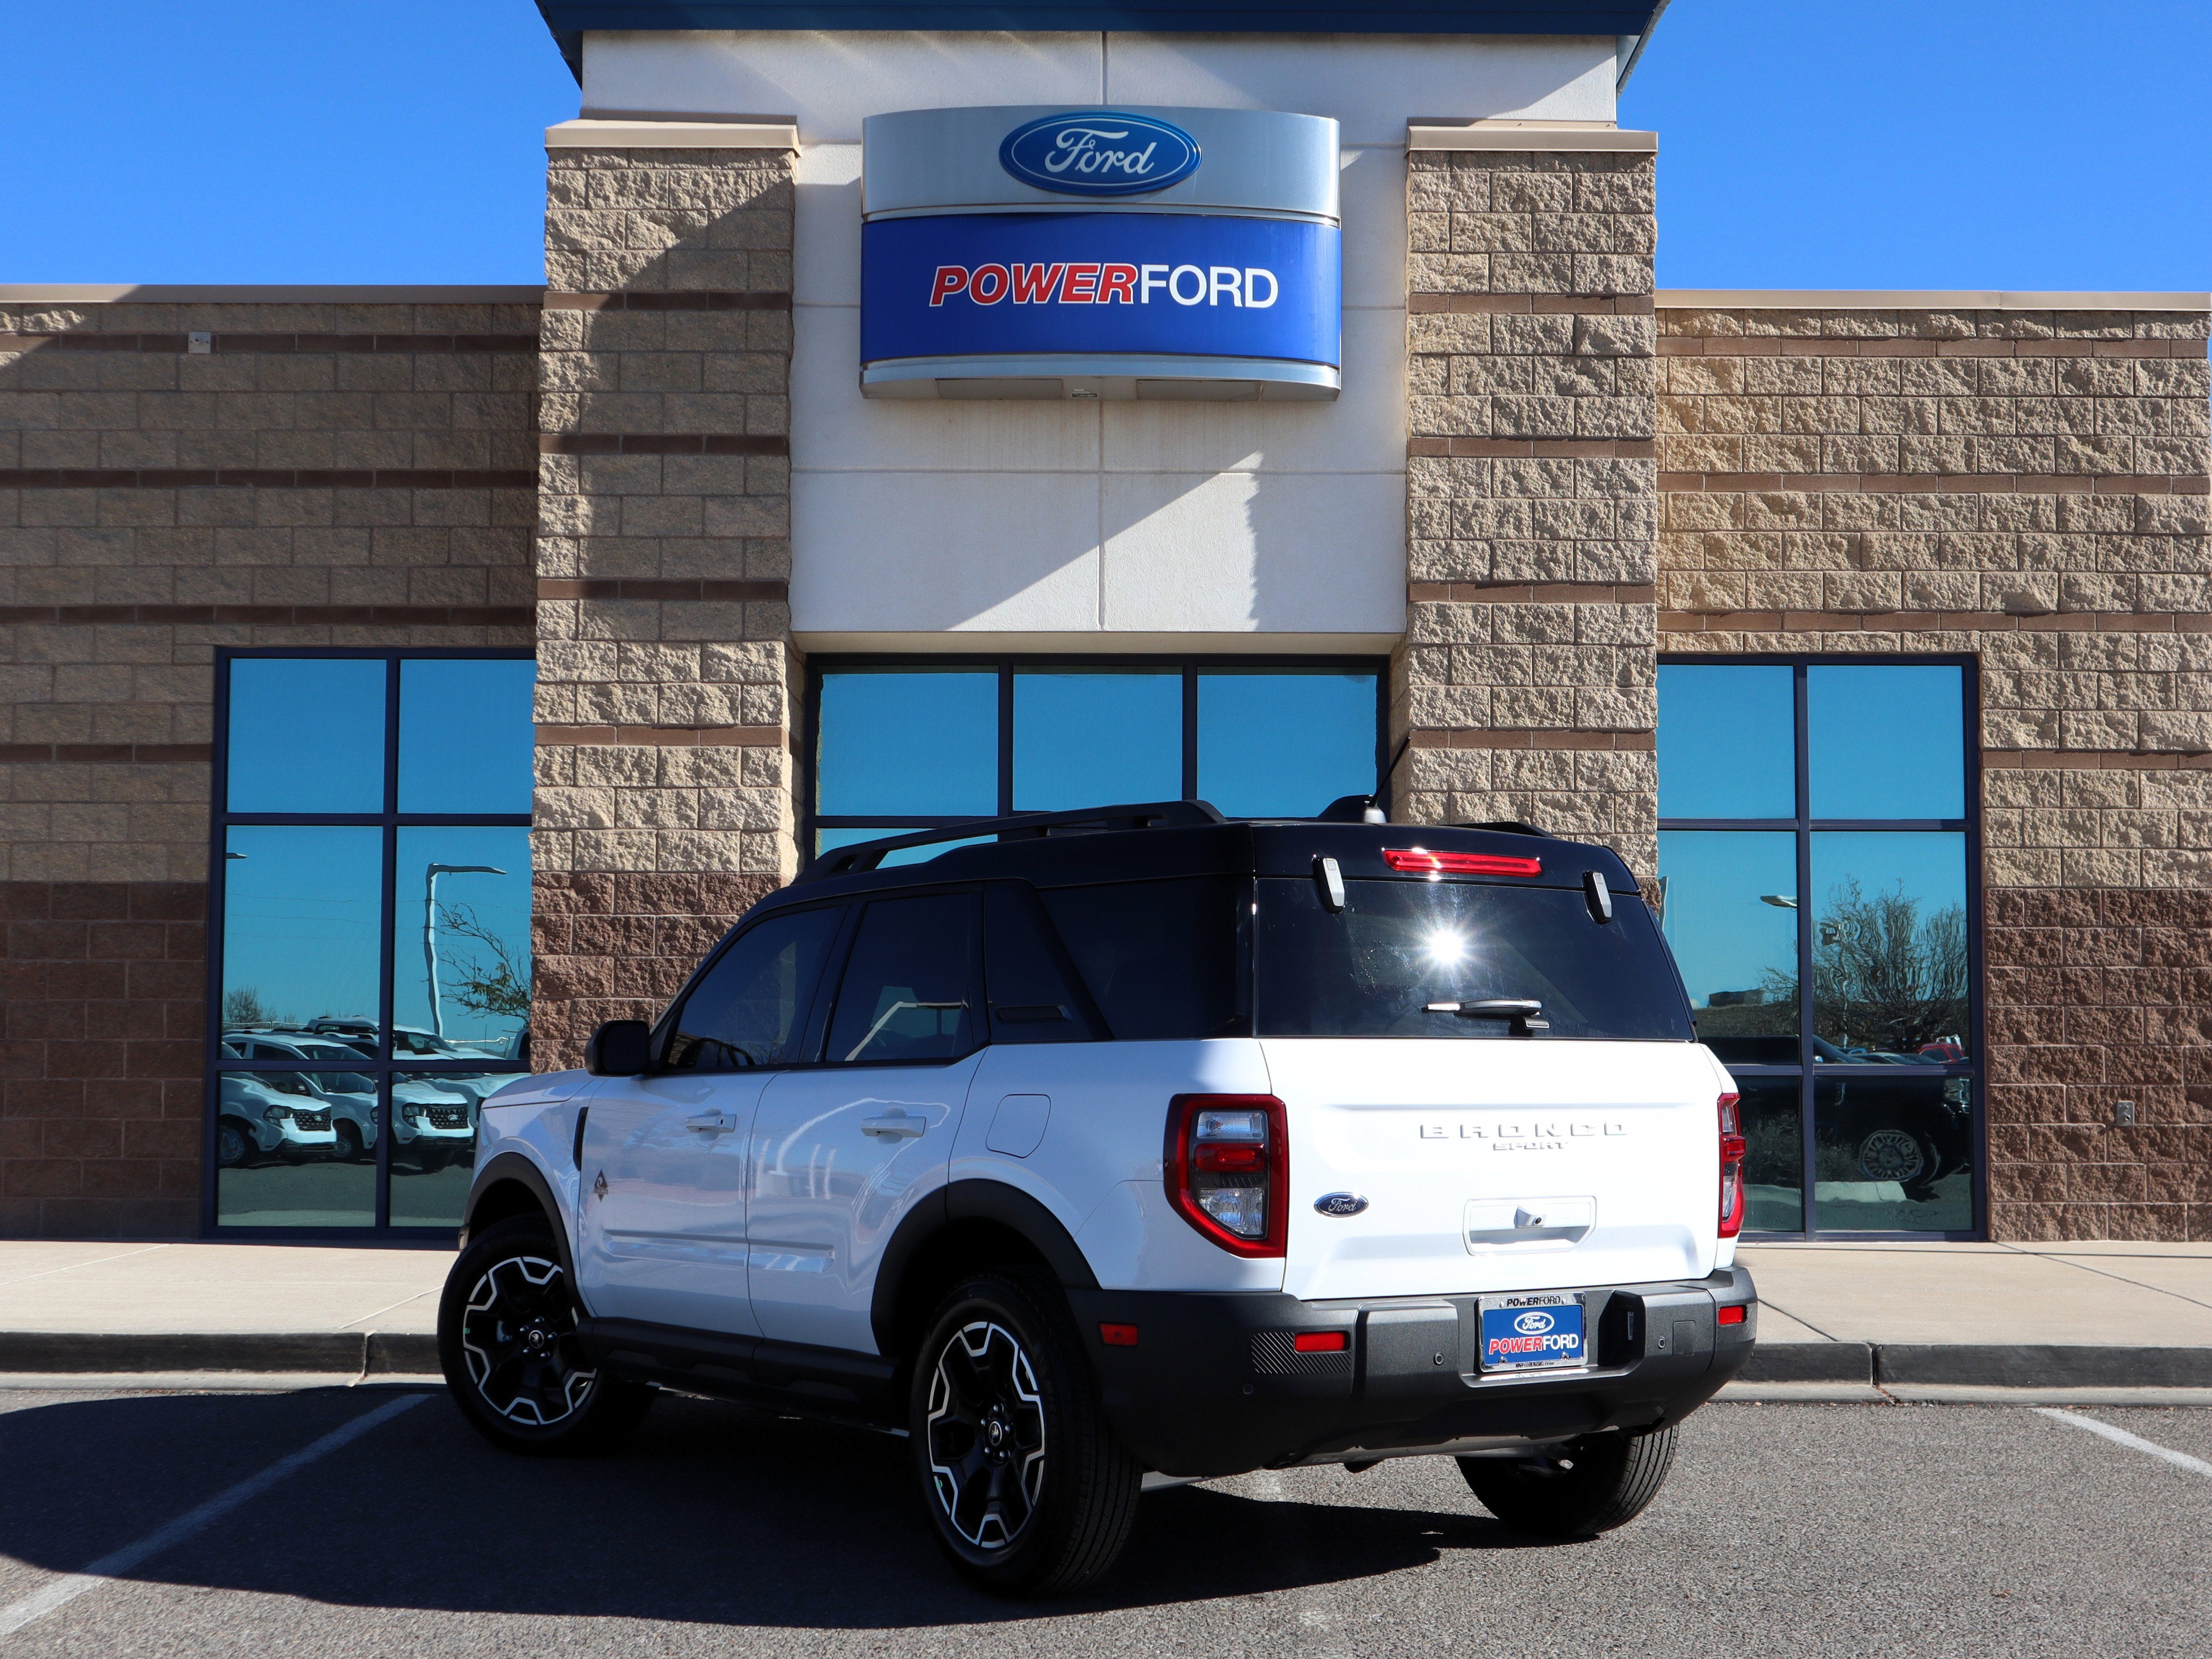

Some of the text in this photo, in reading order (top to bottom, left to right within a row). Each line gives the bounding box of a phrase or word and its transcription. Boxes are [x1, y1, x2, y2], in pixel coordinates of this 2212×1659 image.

[1045, 128, 1157, 174] Ford
[929, 263, 1278, 308] POWERFORD
[1420, 1122, 1627, 1138] BRONCO
[1493, 1141, 1569, 1151] SPORT
[1328, 1198, 1357, 1212] Ford
[1507, 1296, 1561, 1307] POWERFORD
[1522, 1316, 1546, 1329] Ford
[1489, 1334, 1579, 1355] POWERFORD
